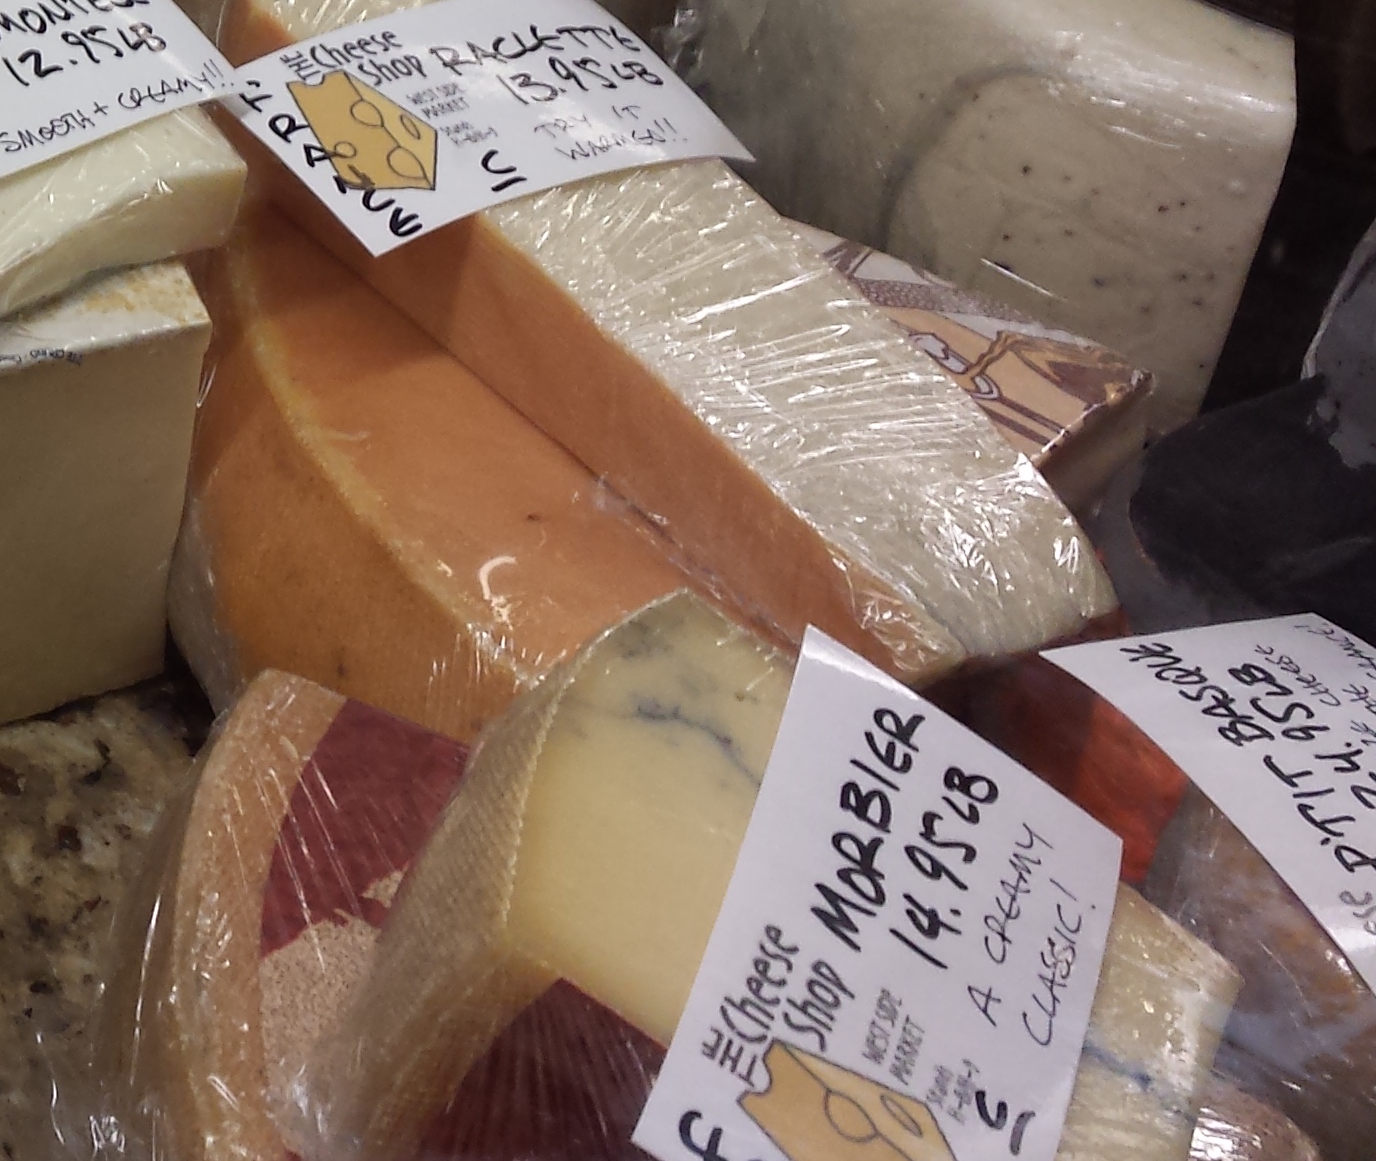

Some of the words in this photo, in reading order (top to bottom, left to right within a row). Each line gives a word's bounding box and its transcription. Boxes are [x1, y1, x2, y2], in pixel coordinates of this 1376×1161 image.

[279, 48, 317, 85] THE
[310, 30, 398, 70] Cheese
[358, 52, 427, 87] Shop
[429, 24, 644, 76] RACLETTE
[533, 110, 593, 140] TRY
[610, 103, 642, 121] IT
[808, 706, 928, 954] MORBIER
[982, 821, 1056, 965] CREAMY
[718, 922, 800, 1045] Cheese
[780, 958, 857, 1053] Shop
[966, 983, 1002, 1027] A
[701, 1025, 756, 1088] THE
